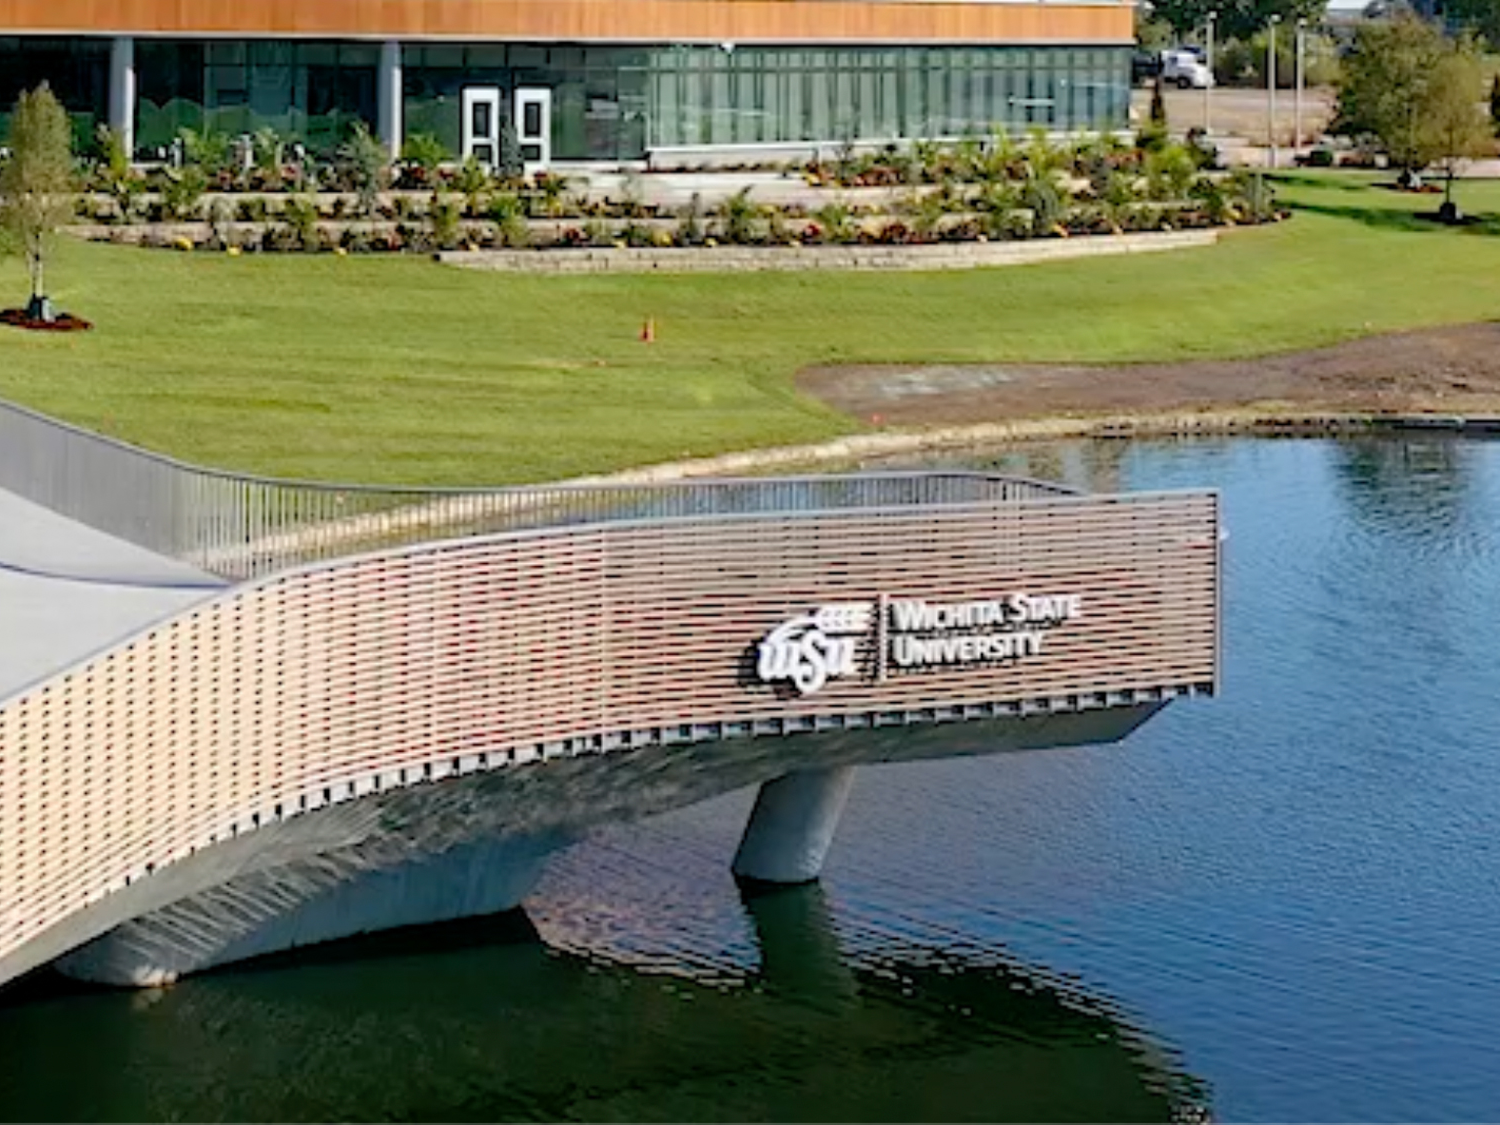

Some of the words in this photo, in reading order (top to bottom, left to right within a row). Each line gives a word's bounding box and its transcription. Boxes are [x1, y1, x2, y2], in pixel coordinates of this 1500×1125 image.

[892, 600, 1002, 631] WICHITA
[1013, 593, 1083, 621] STATE
[897, 631, 1045, 666] UNIVERSITY
